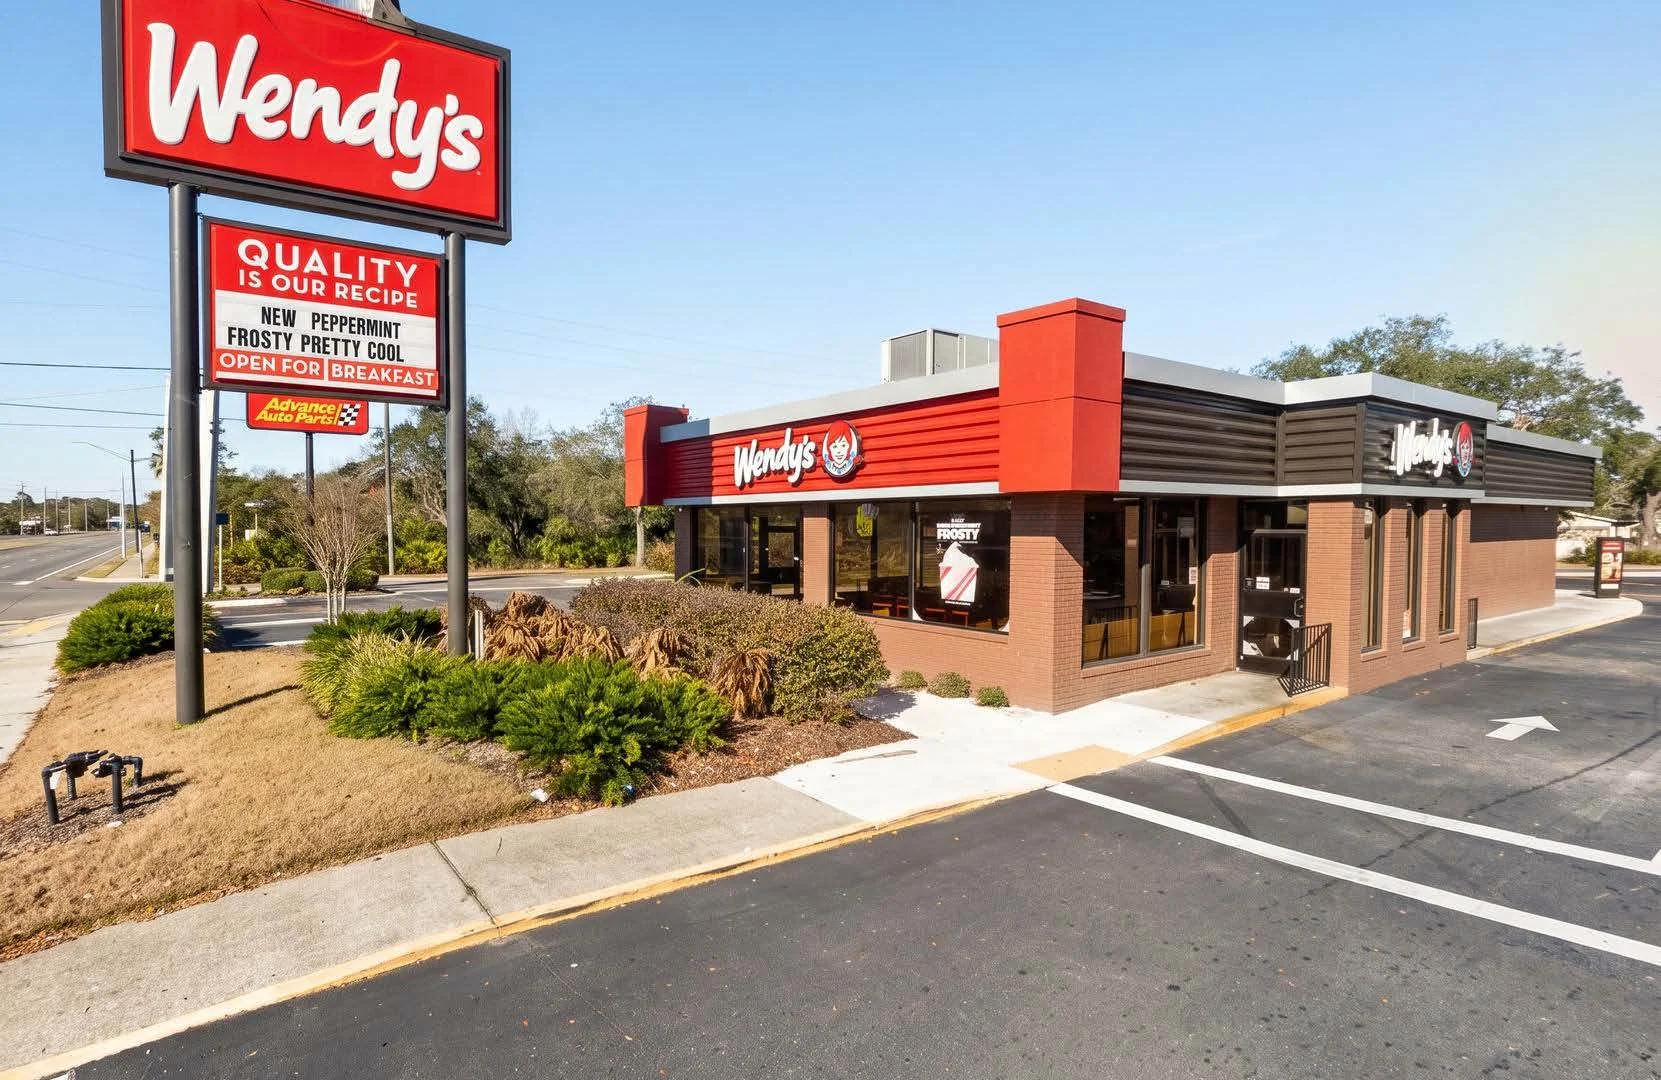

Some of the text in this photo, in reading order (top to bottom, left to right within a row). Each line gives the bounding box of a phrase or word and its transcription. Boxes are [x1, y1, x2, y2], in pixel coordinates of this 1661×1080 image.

[146, 22, 484, 191] Wendy's
[237, 238, 418, 288] QUALITY
[238, 269, 418, 309] IS OUR RECIPE
[261, 306, 401, 340] NEW PEPPERMINT
[227, 326, 405, 363] FROSTY PRETTY COOL
[219, 352, 435, 387] OPEN FOR BREAKFAST
[256, 409, 335, 426] Auto Parts
[263, 397, 337, 414] Advance
[734, 427, 816, 487] Wendy's
[936, 528, 980, 541] FROSTY
